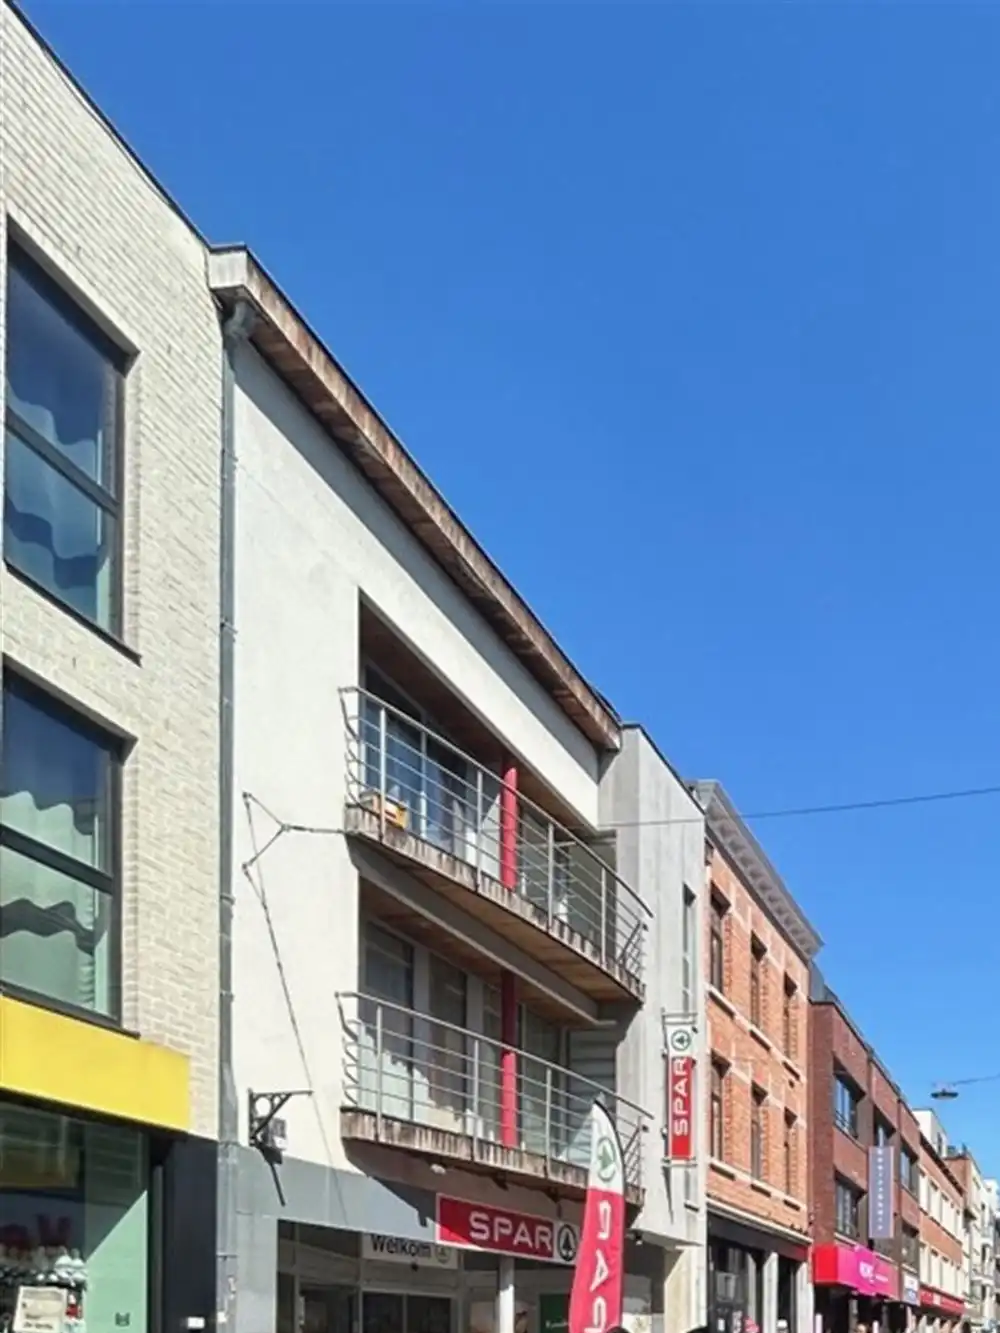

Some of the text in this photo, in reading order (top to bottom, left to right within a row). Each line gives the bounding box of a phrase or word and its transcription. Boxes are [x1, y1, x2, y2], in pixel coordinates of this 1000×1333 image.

[673, 1058, 689, 1137] SPAR
[370, 1233, 431, 1258] Welkom
[469, 1210, 552, 1252] SPAR
